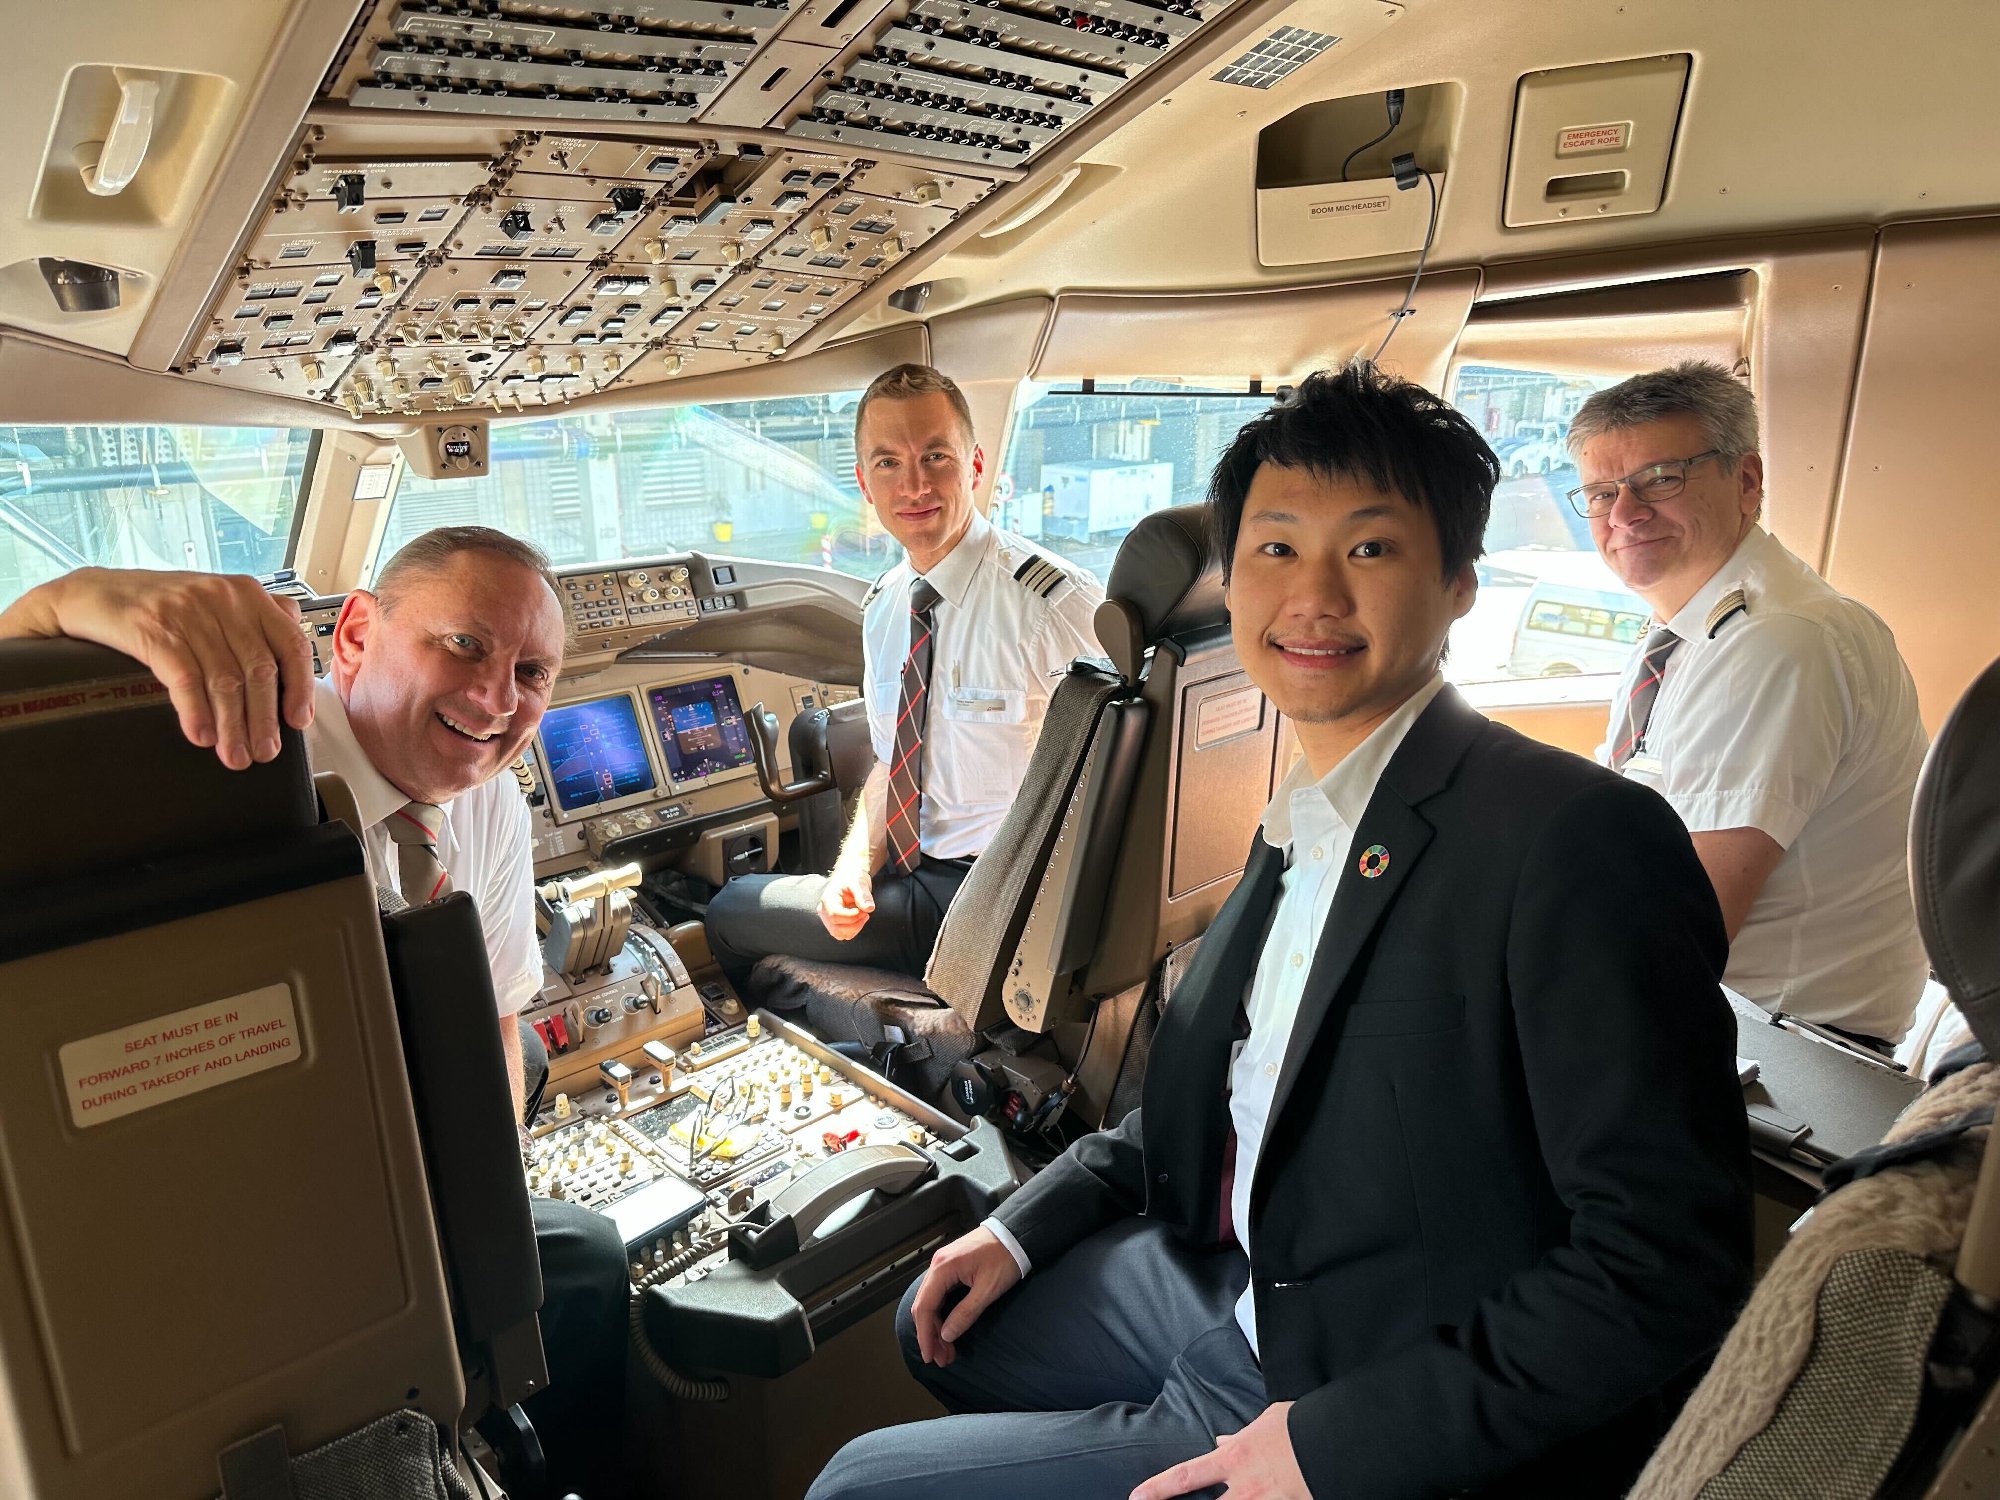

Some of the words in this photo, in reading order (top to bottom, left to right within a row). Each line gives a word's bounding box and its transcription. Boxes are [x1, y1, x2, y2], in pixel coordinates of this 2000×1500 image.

[1563, 139, 1596, 149] ESCAPE
[1597, 136, 1621, 145] ROPE
[1567, 128, 1619, 140] EMERGENCY
[1311, 206, 1334, 215] BOOM
[1335, 201, 1387, 212] MIC/HEADSET
[124, 1034, 158, 1053] SEAT
[162, 1022, 200, 1042] MUST
[204, 1016, 222, 1030] BE
[225, 1011, 239, 1024] IN
[78, 1059, 150, 1089] FORWARD
[153, 1055, 161, 1065] 7
[165, 1040, 215, 1063] INCHES
[218, 1033, 236, 1046] OF
[239, 1018, 287, 1039] TRAVEL
[81, 1085, 138, 1110] DURING
[141, 1064, 200, 1091] TAKEOFF
[204, 1056, 232, 1072] AND
[235, 1037, 291, 1062] LANDING
